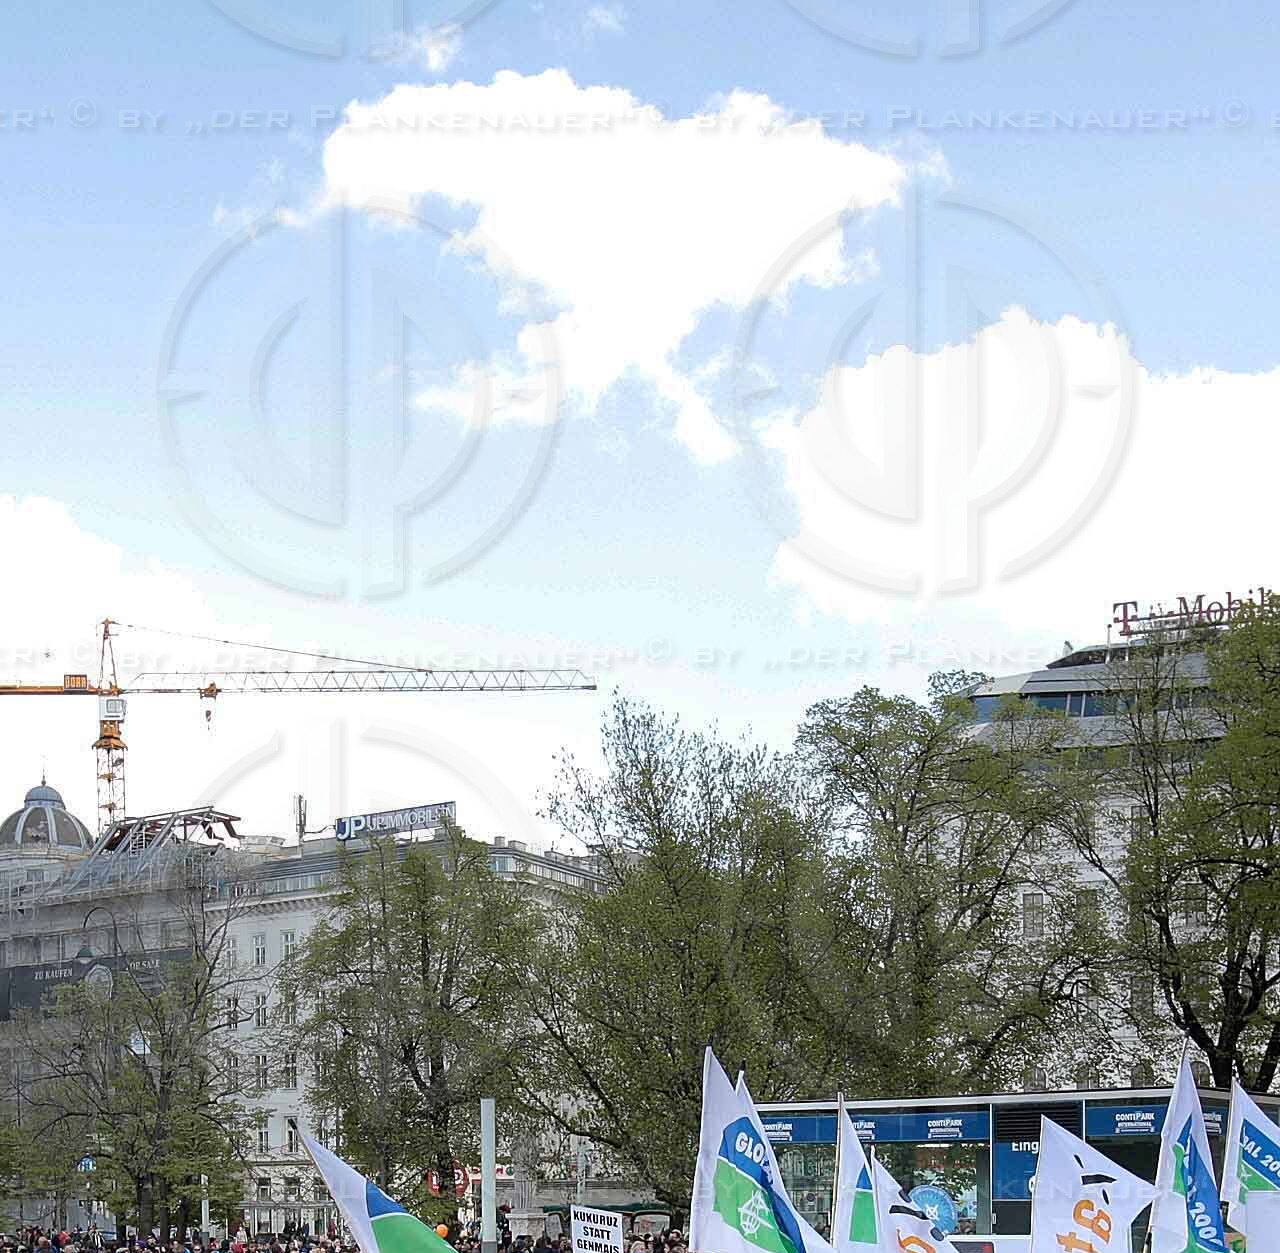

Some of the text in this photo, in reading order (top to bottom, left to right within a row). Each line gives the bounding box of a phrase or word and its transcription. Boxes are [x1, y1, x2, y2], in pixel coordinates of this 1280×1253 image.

[1176, 588, 1271, 627] Mobil
[573, 1210, 619, 1228] KUKURUZ
[583, 1226, 611, 1241] STATT
